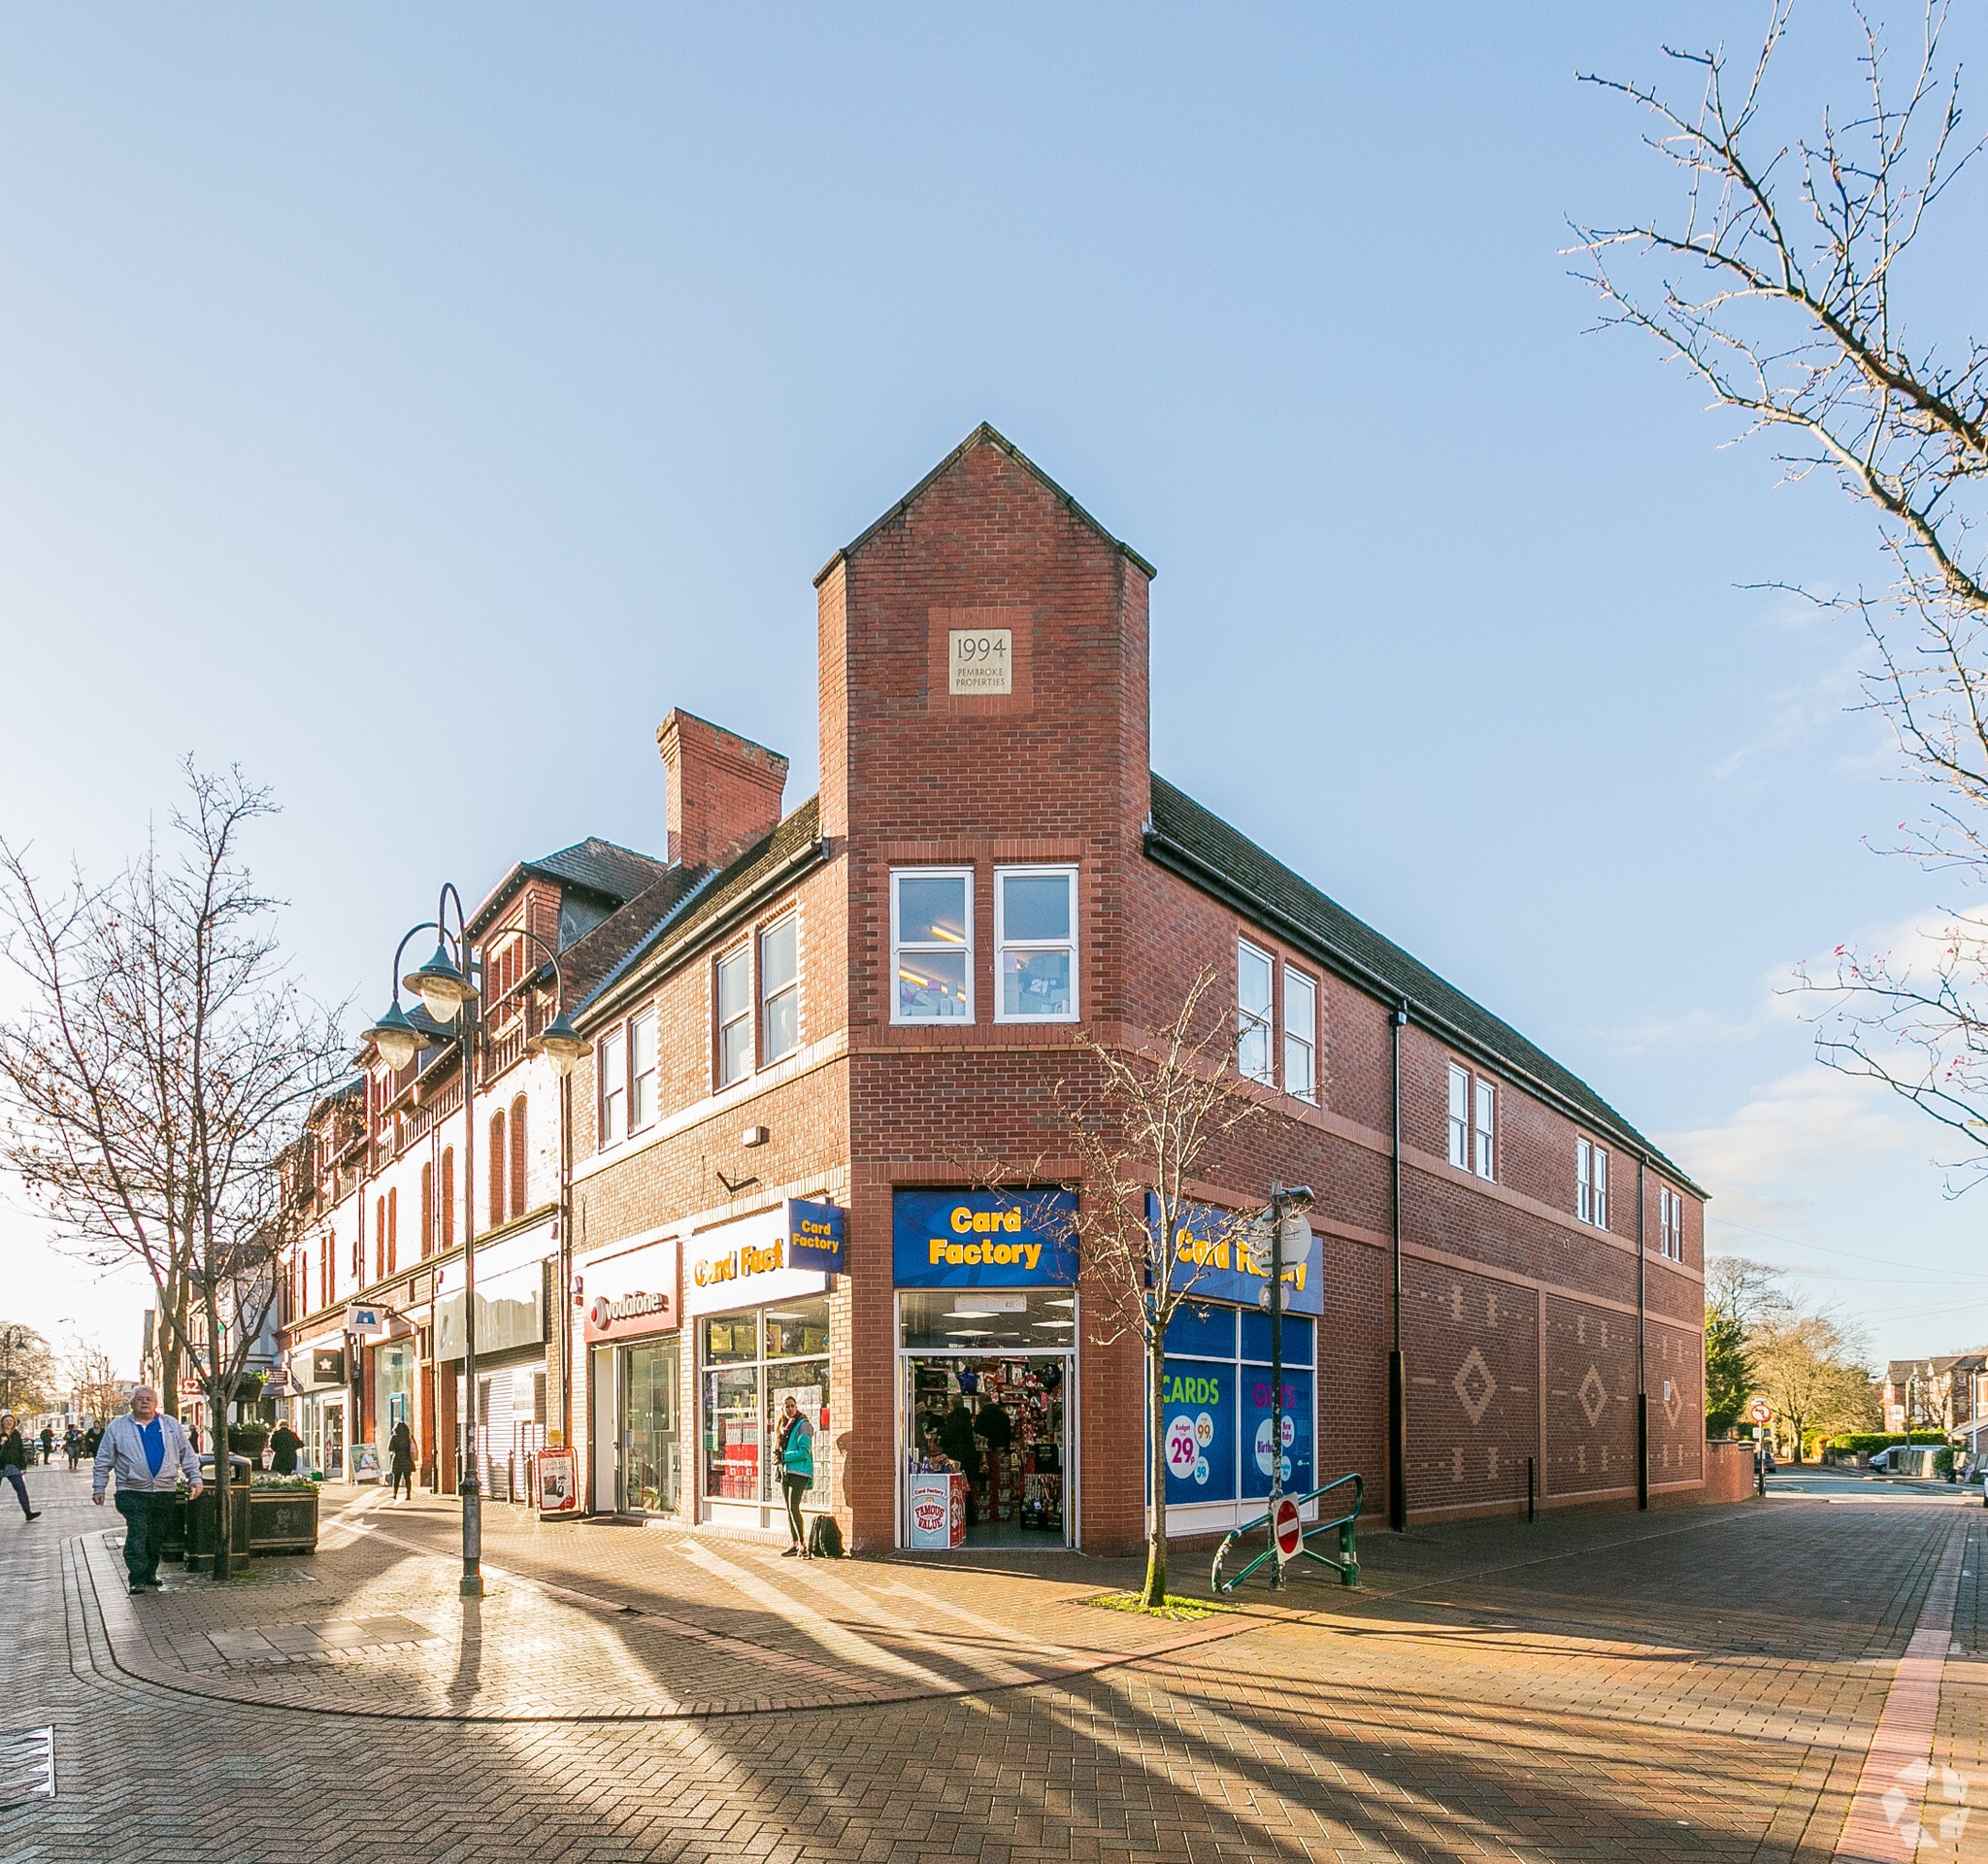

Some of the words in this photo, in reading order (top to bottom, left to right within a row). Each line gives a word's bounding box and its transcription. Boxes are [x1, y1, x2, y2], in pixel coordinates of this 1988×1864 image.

[957, 638, 1007, 661] 1994
[955, 678, 1006, 686] PROPERTIES
[957, 668, 1004, 677] PEMBROKE
[801, 1219, 831, 1236] Card
[950, 1207, 1022, 1234] Card
[792, 1233, 840, 1254] Factory
[929, 1239, 1043, 1270] Factory
[1176, 1228, 1230, 1270] Card
[694, 1250, 737, 1287] Card
[741, 1238, 783, 1277] Fact
[606, 1291, 666, 1320] vodafone
[1163, 1375, 1219, 1405] CARDS
[1253, 1382, 1296, 1409] GITS
[1171, 1437, 1196, 1466] 29p
[915, 1505, 945, 1517] FAMOUS
[917, 1516, 944, 1530] VALUE
